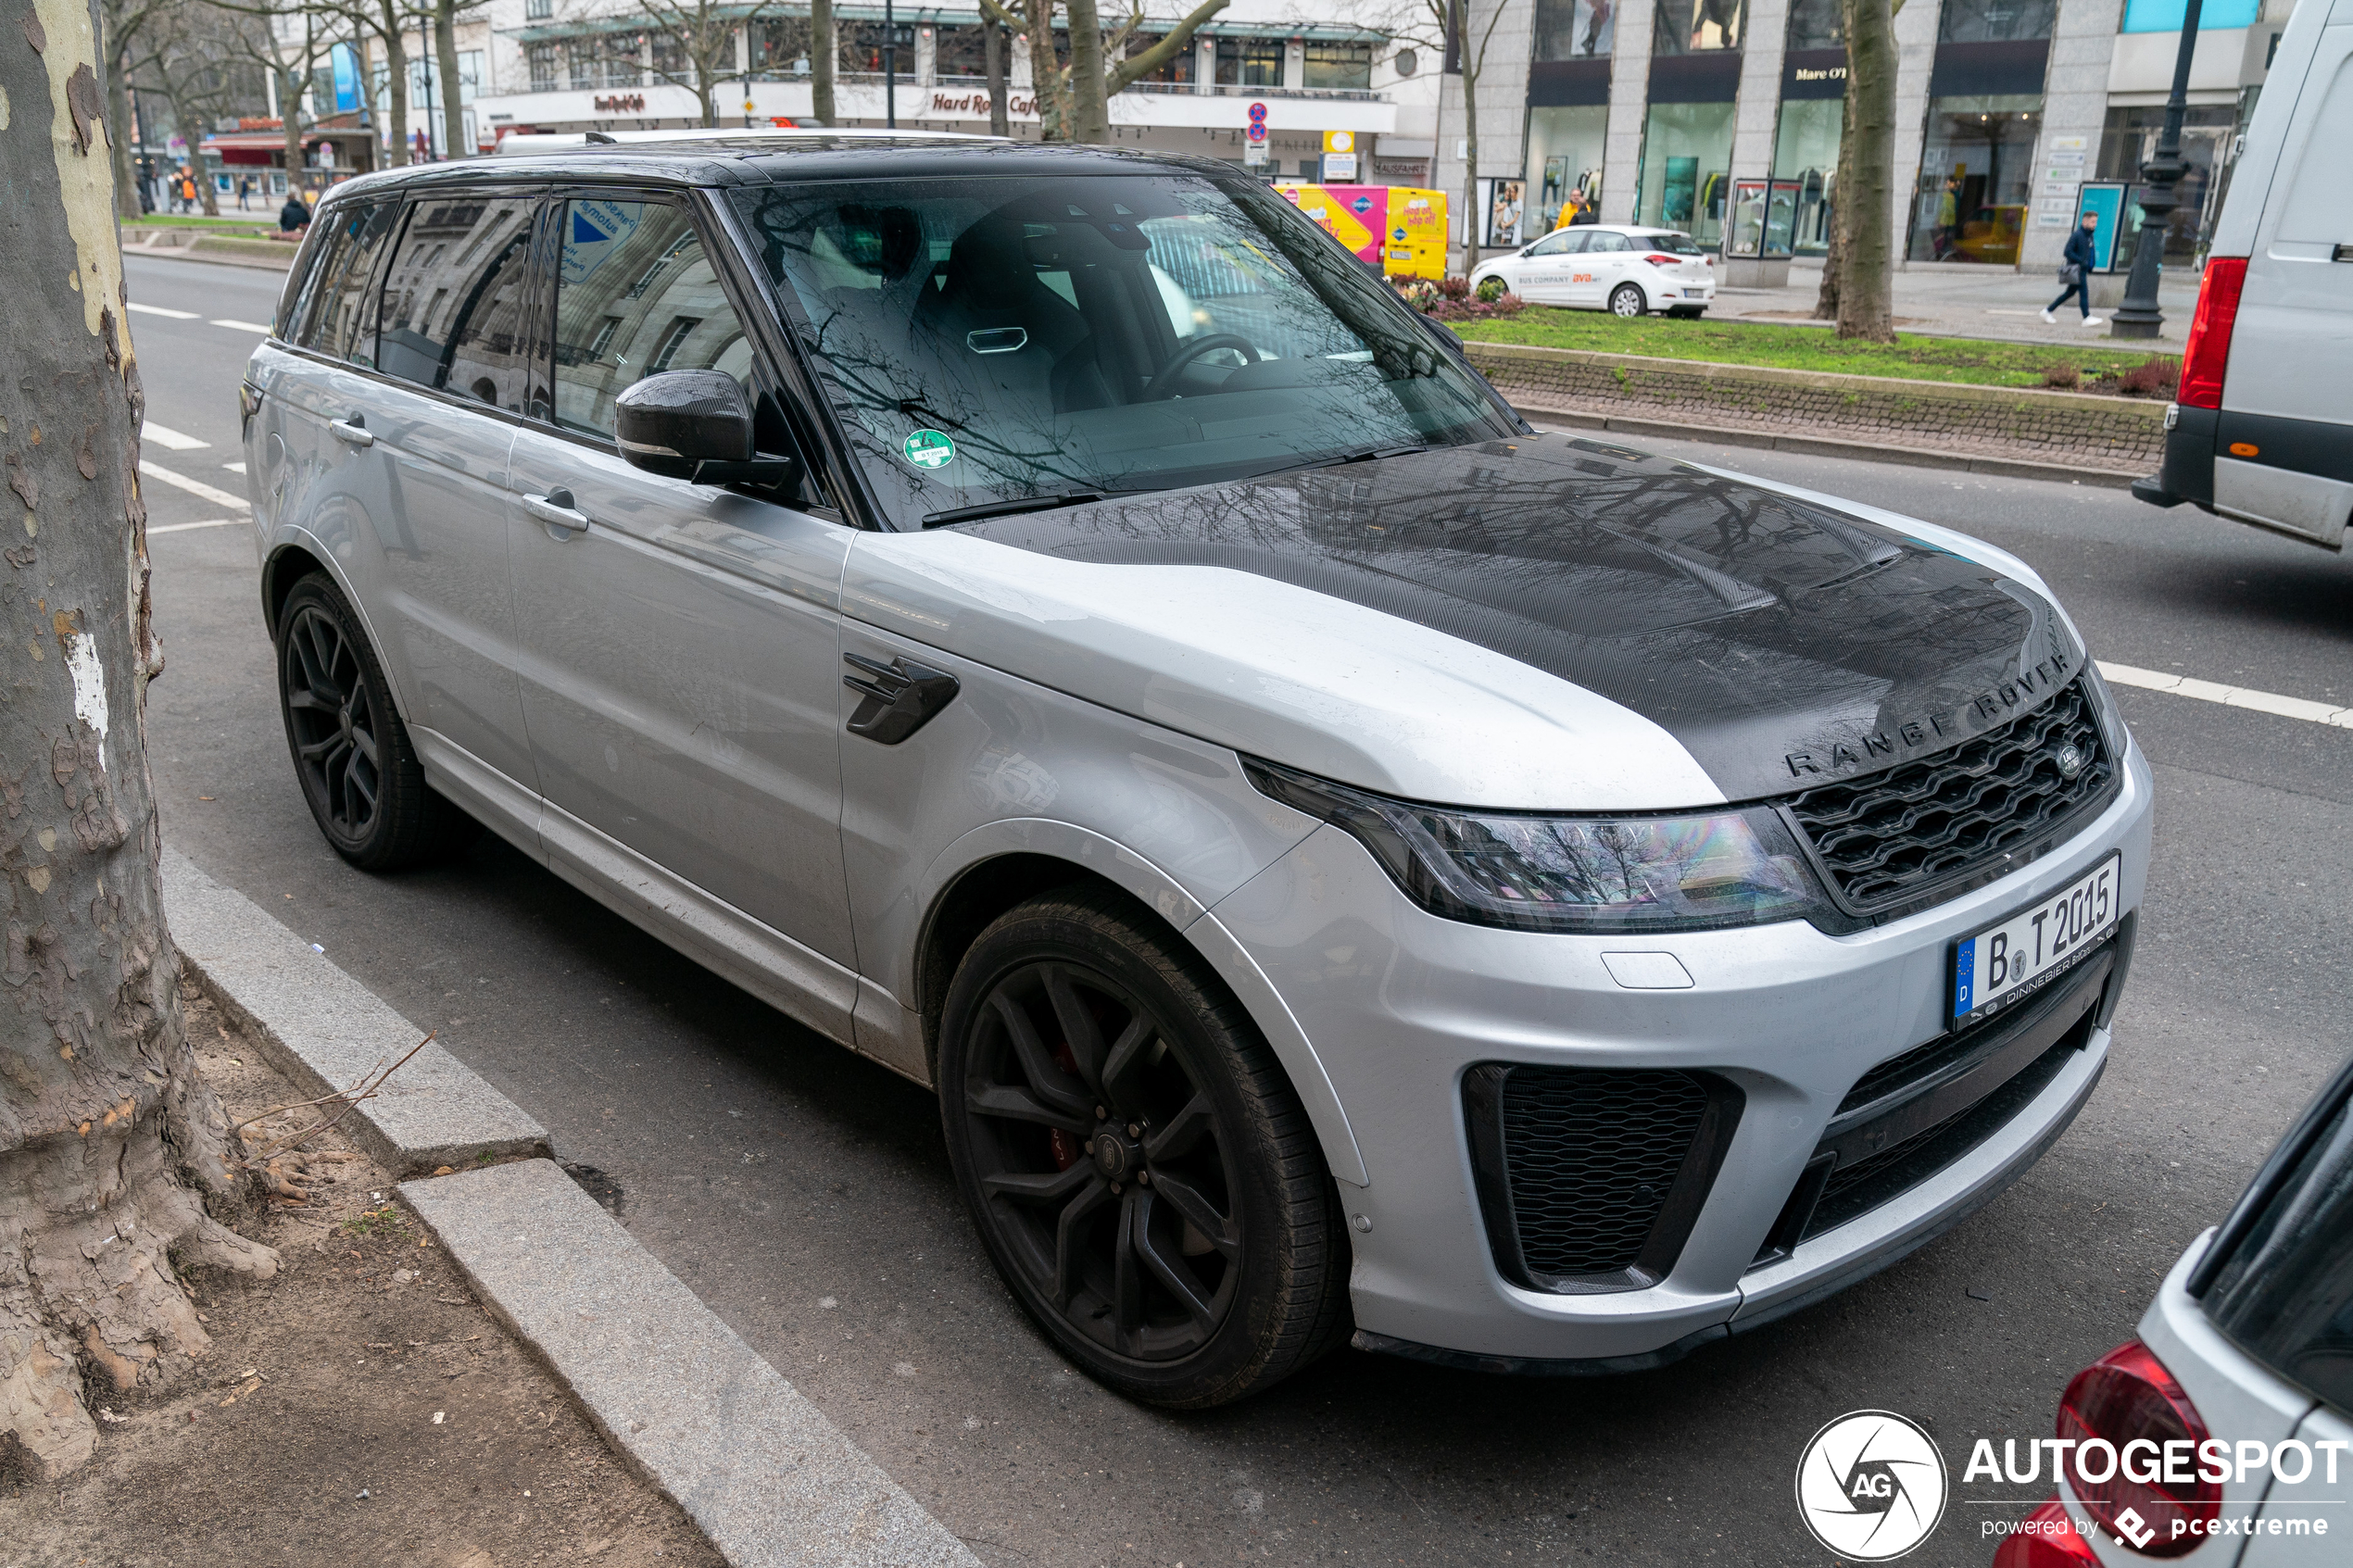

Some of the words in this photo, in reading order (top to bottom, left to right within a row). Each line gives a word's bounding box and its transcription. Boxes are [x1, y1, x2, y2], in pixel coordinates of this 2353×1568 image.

[933, 94, 970, 110] Hard
[973, 94, 991, 114] Ro
[1534, 276, 1569, 284] COMPANY
[921, 432, 936, 448] 4
[1784, 711, 1957, 777] RANGE
[1974, 651, 2069, 719] ROVER
[1988, 931, 2008, 991] B
[2032, 909, 2048, 967] T
[2053, 868, 2109, 956] 2015
[1959, 985, 1968, 1002] D
[2007, 960, 2070, 1004] DINNEBIER
[1052, 1127, 1065, 1160] LAN
